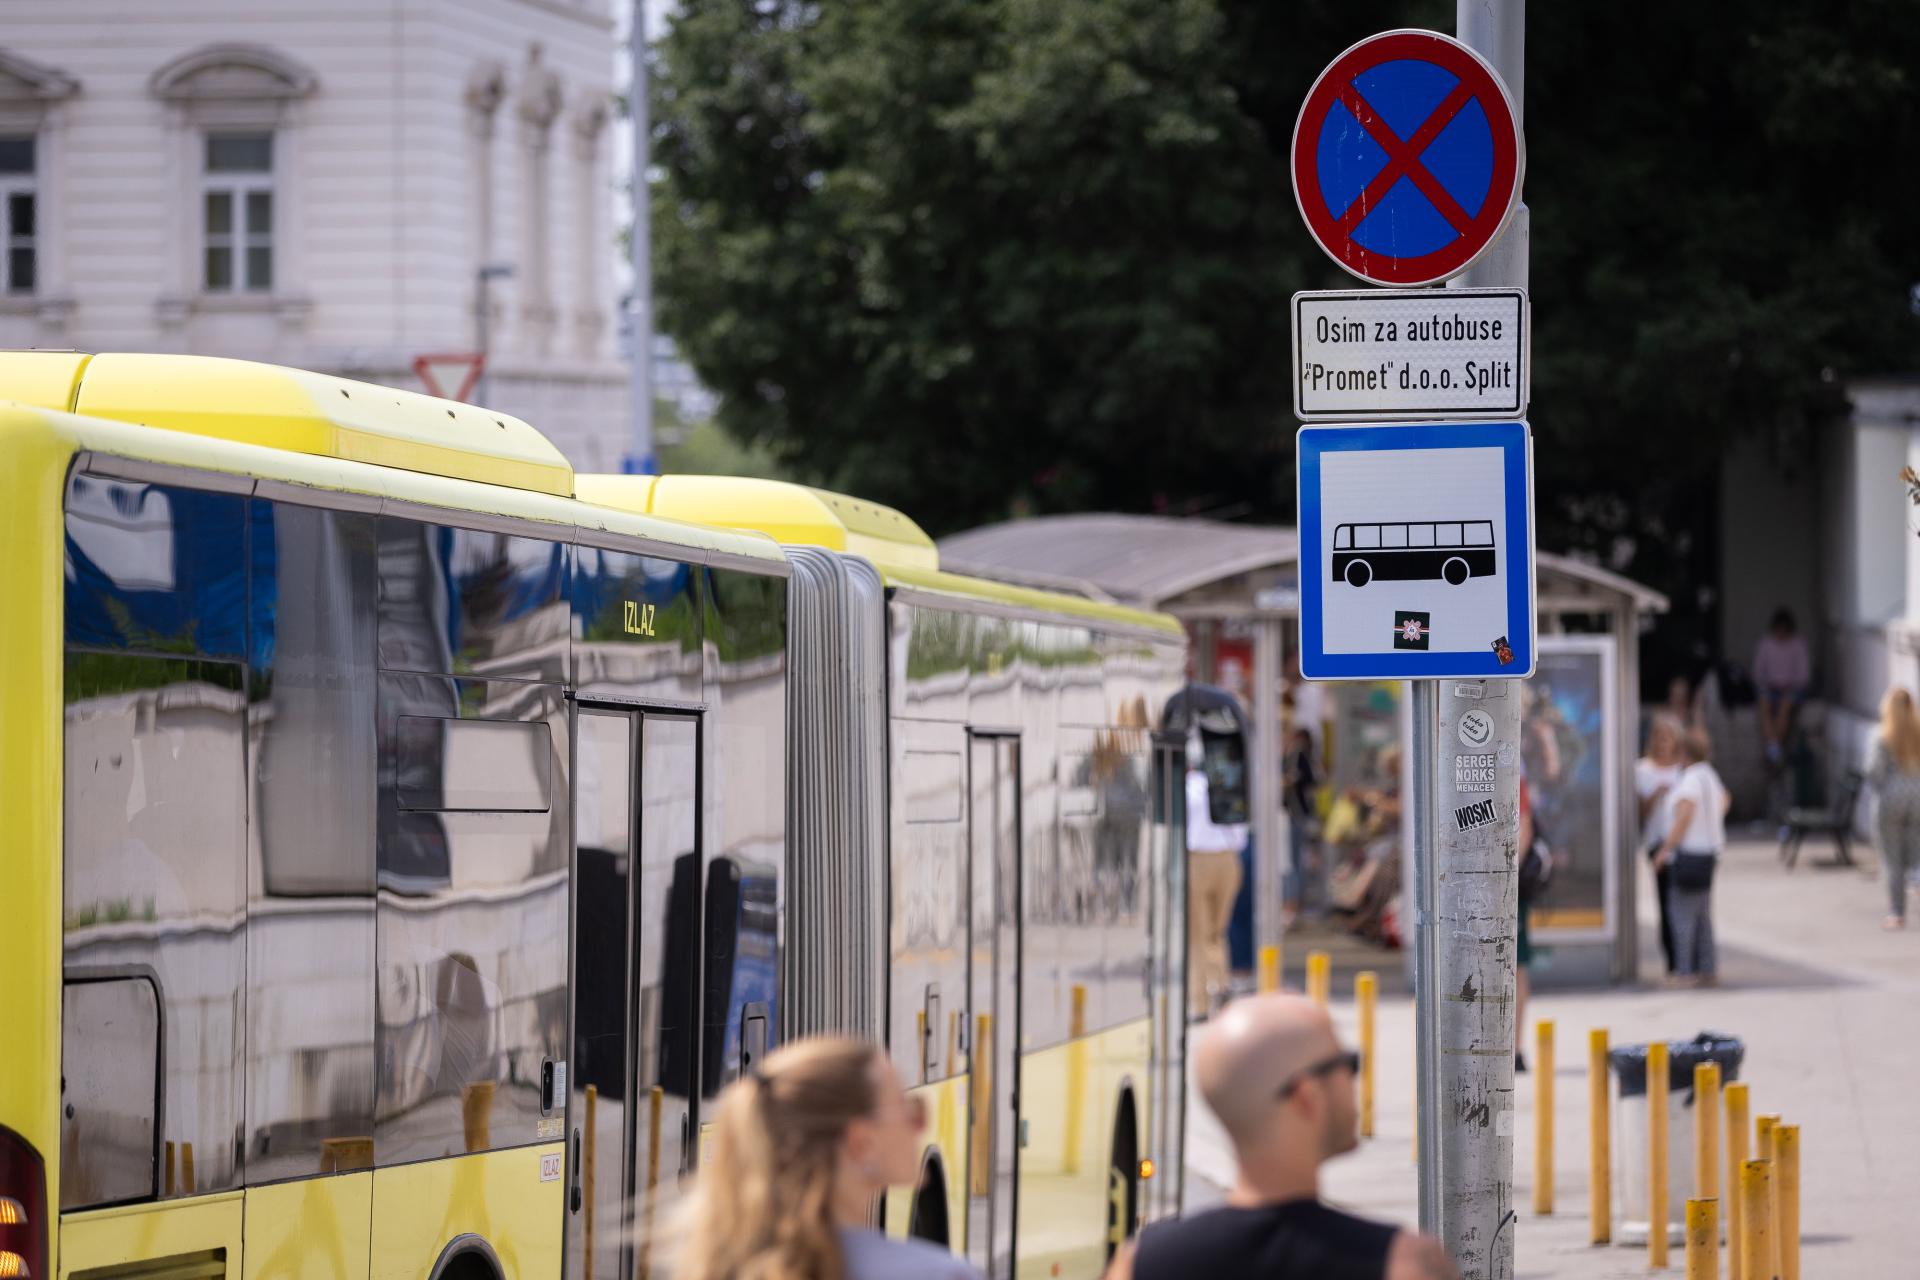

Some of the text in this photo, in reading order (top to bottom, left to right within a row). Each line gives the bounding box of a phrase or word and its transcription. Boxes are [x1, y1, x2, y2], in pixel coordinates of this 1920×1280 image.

[1316, 313, 1503, 344] Osim za autobuse
[1305, 360, 1512, 396] "Promet" d.o.o. Split
[624, 600, 656, 637] IZLAZ
[1455, 754, 1495, 768] SERGE
[1455, 768, 1495, 782] NORKS
[1456, 783, 1496, 792] MENACES
[1454, 798, 1496, 829] WOSNT
